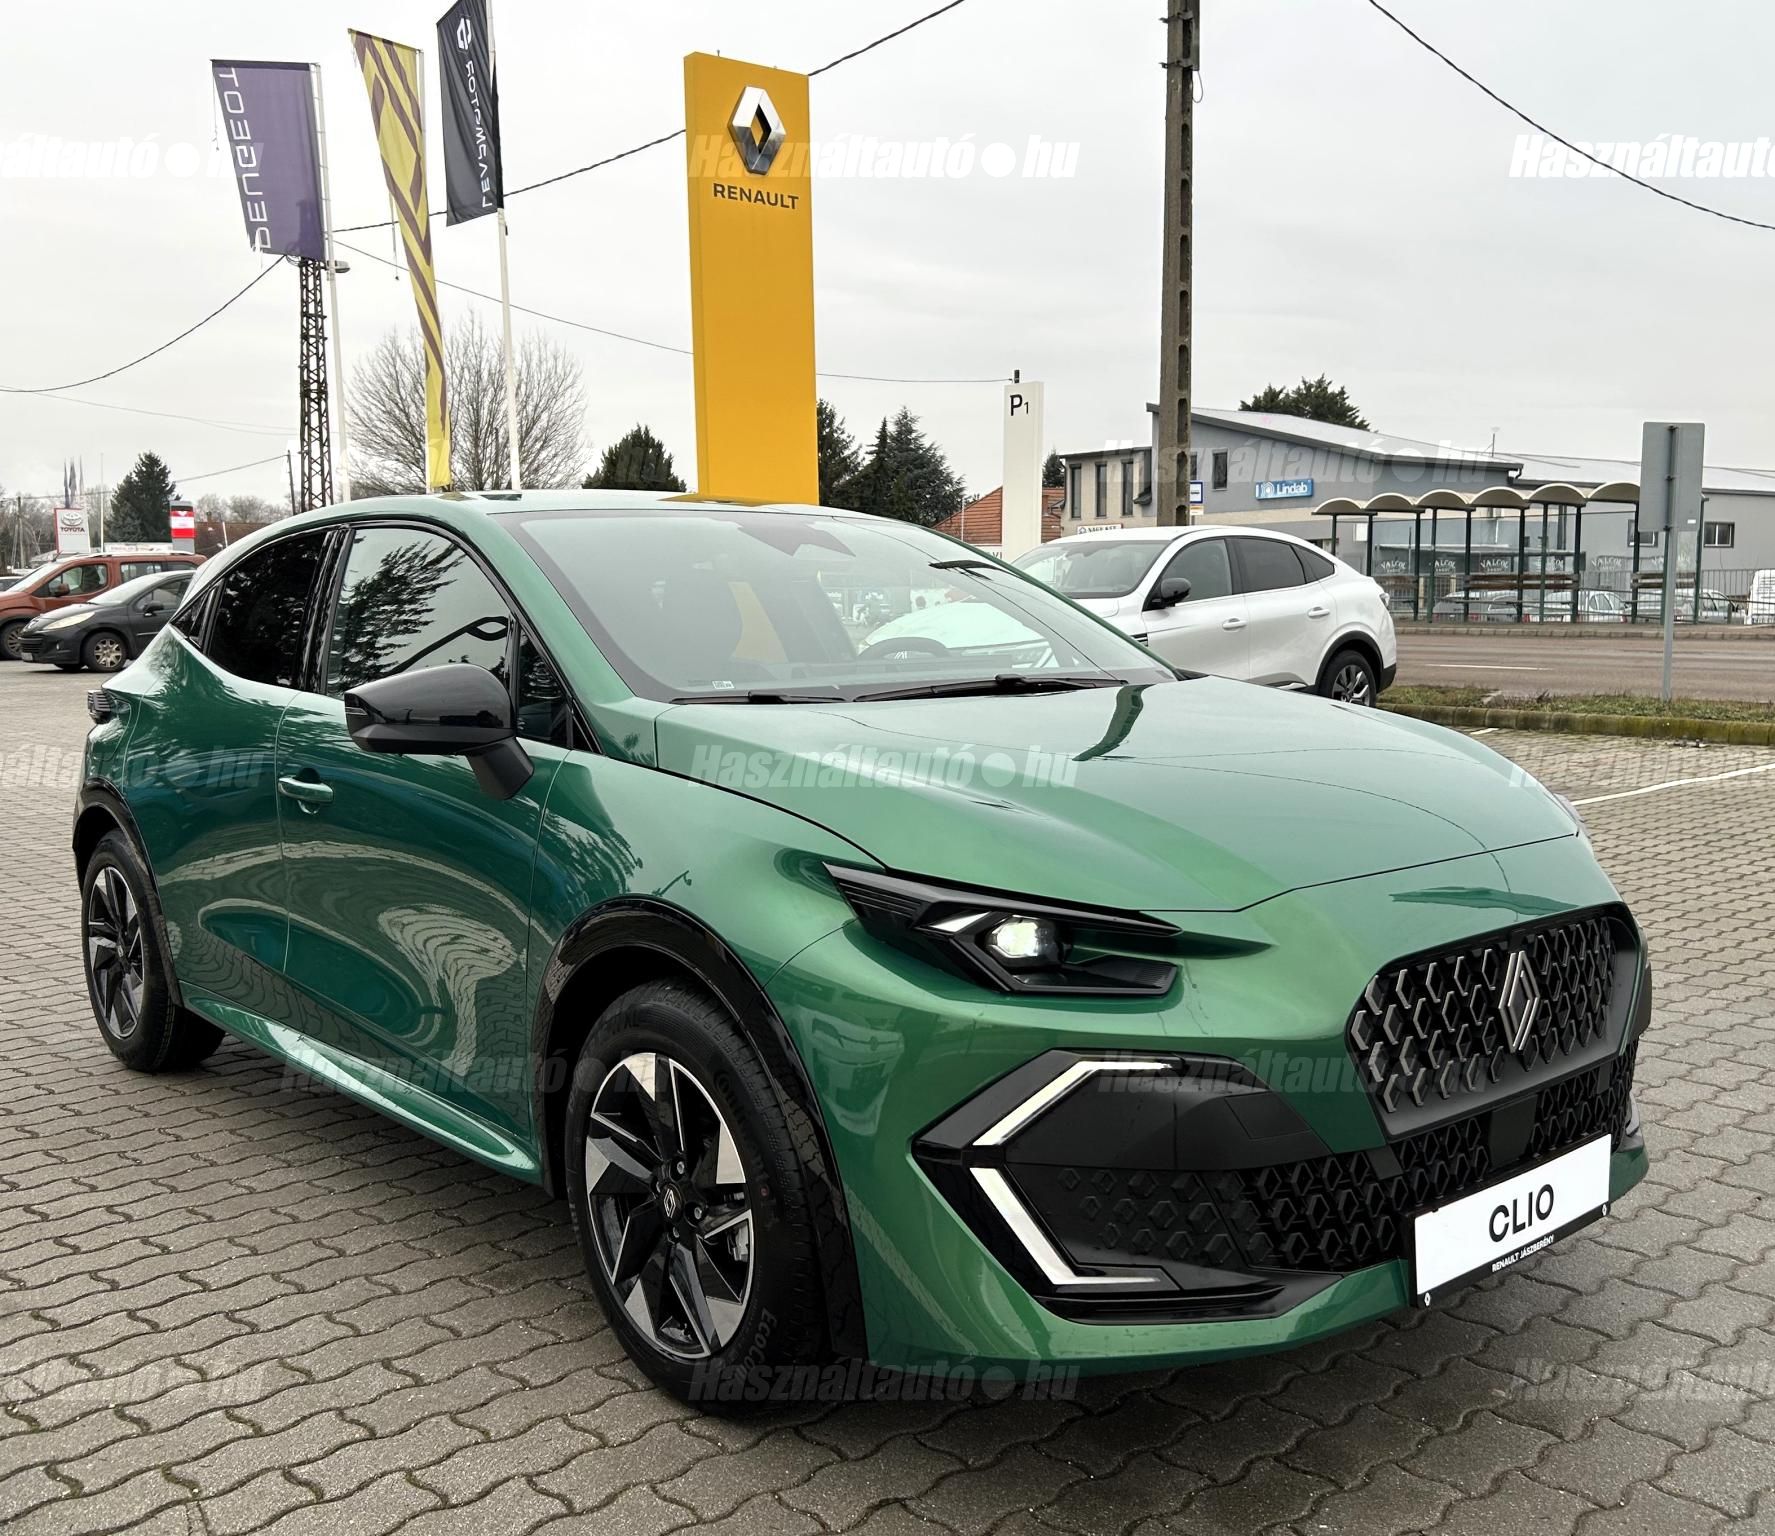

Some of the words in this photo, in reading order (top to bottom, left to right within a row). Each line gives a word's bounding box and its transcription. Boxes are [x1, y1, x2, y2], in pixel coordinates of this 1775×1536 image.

[713, 183, 799, 209] RENAULT
[1277, 481, 1308, 495] Lindab
[1489, 1183, 1554, 1242] CLIO
[1492, 1252, 1520, 1272] RENAULT
[1520, 1234, 1554, 1259] JÁSZBERÉNY
